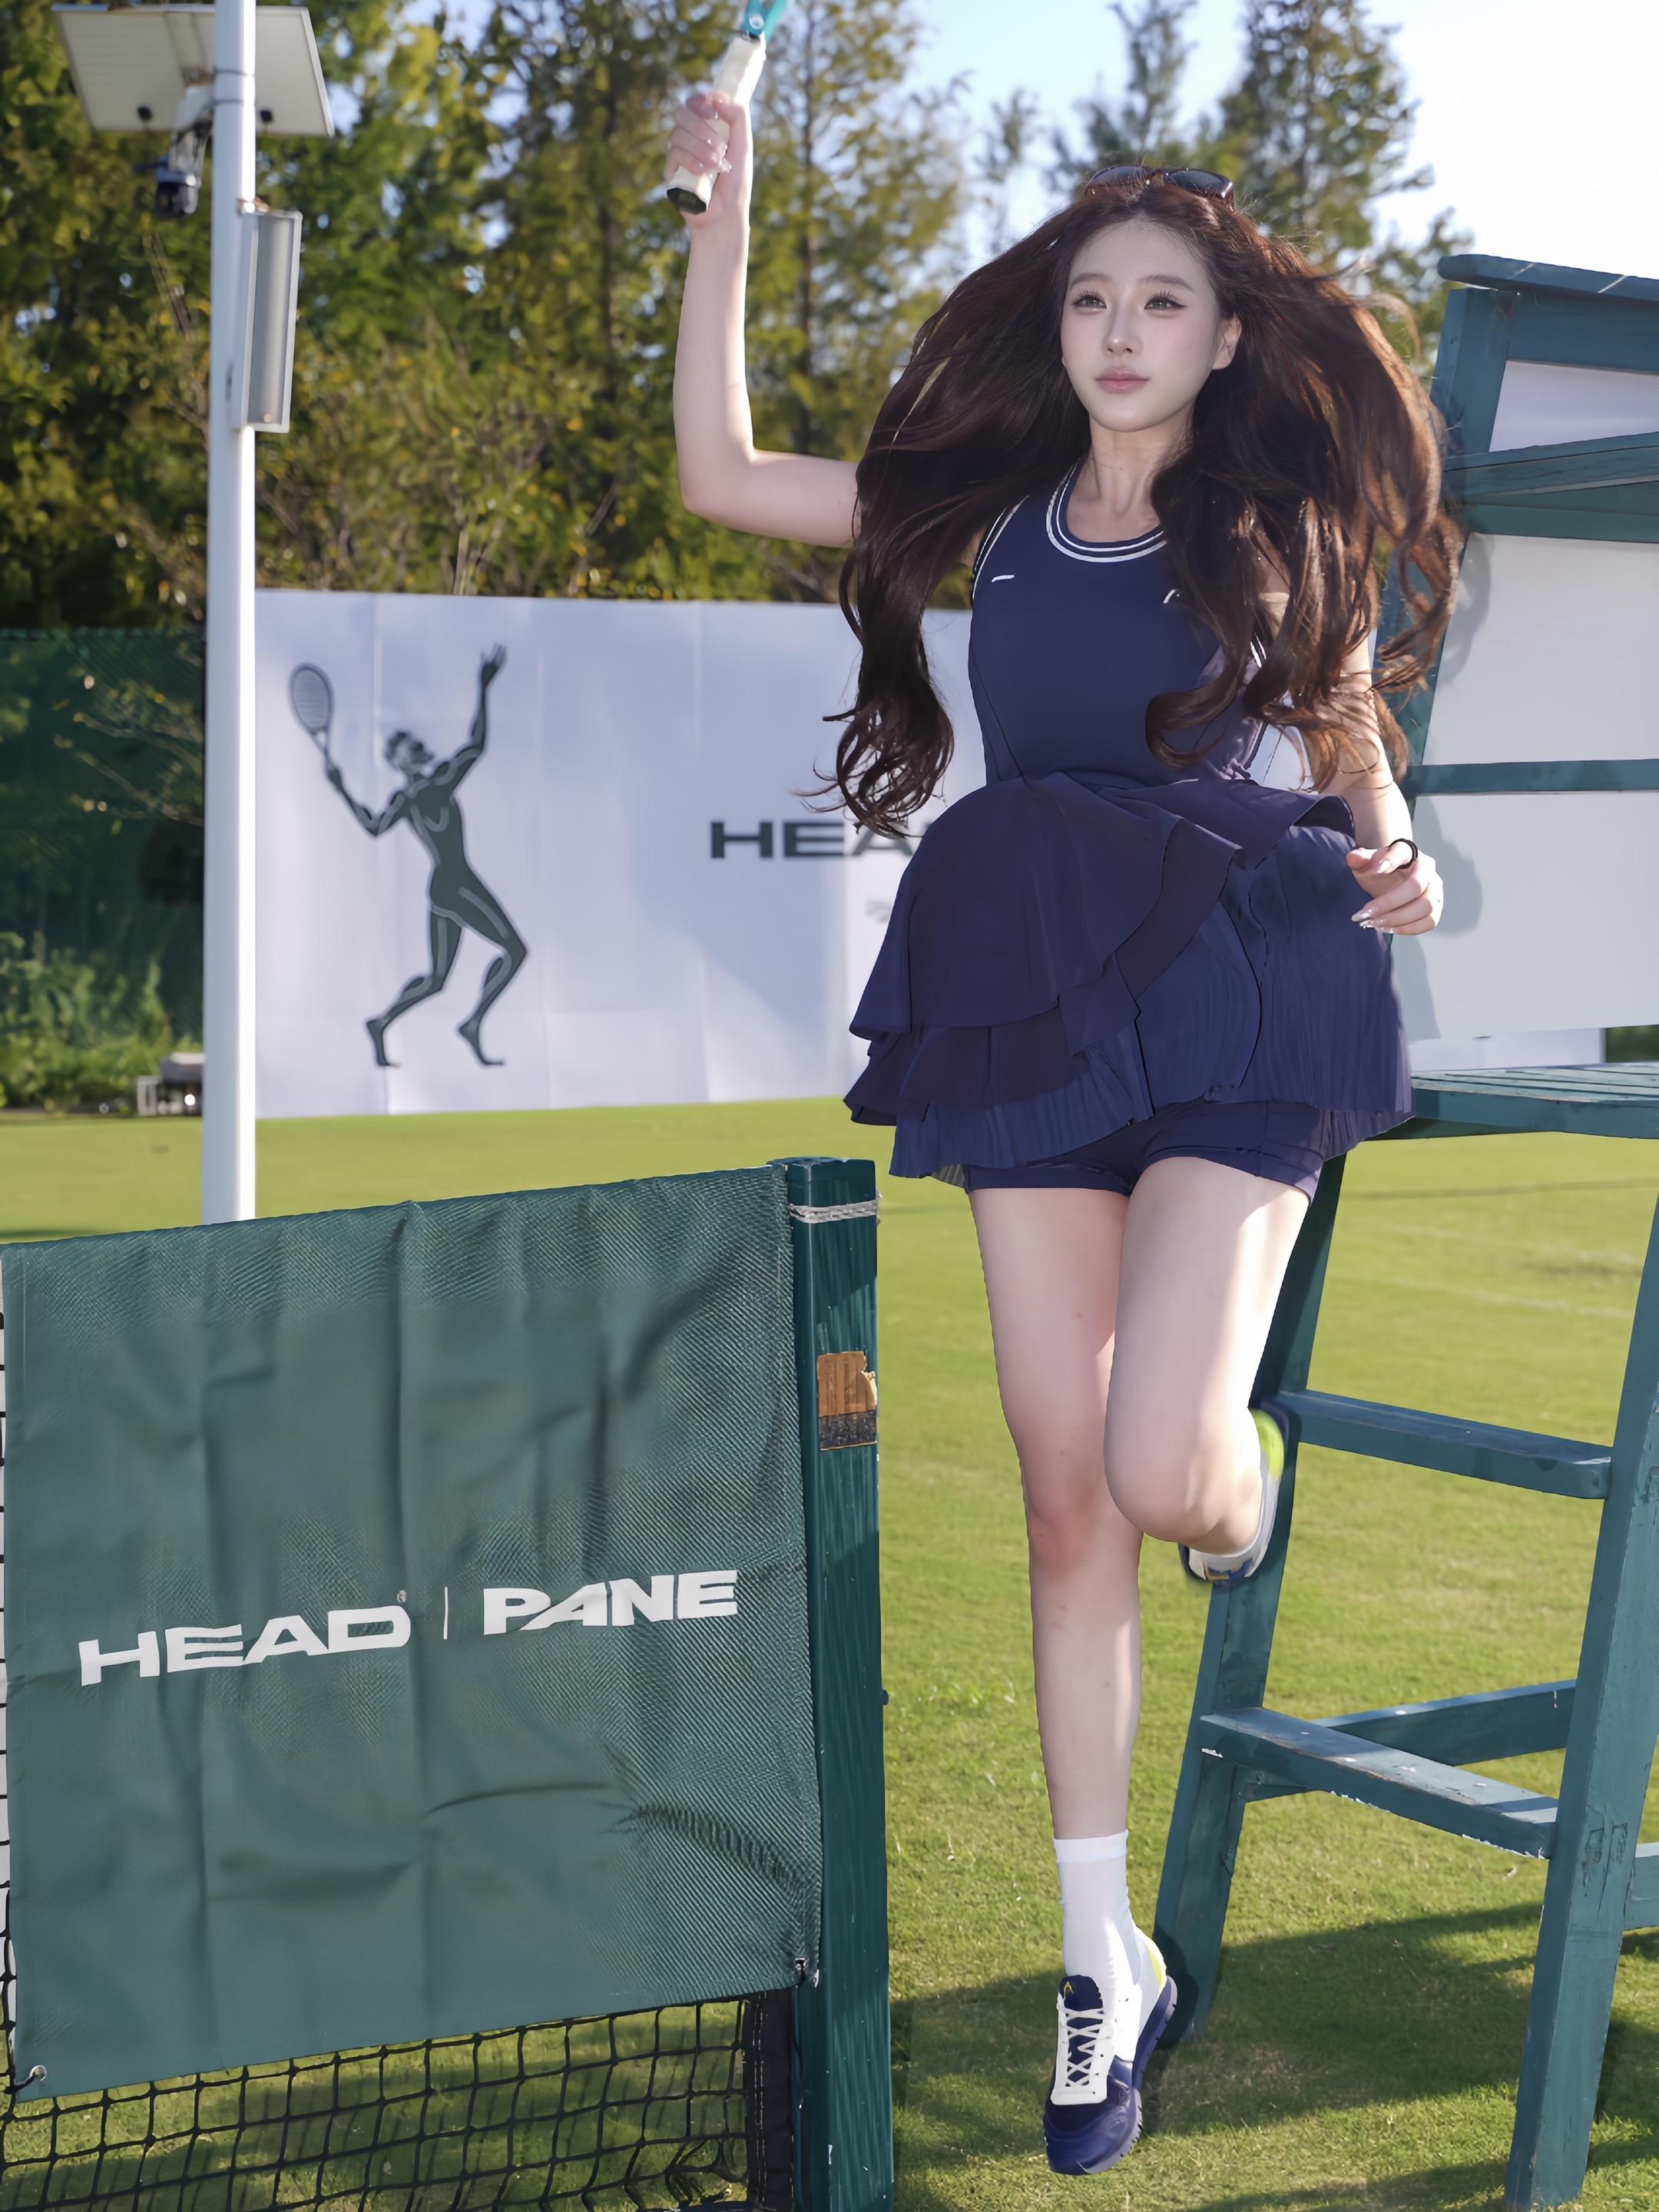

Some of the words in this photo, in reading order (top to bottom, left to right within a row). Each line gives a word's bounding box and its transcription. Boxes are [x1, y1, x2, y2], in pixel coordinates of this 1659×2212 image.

[710, 821, 929, 859] HEA
[78, 1605, 411, 1687] HEAD
[483, 1569, 739, 1635] PANE
